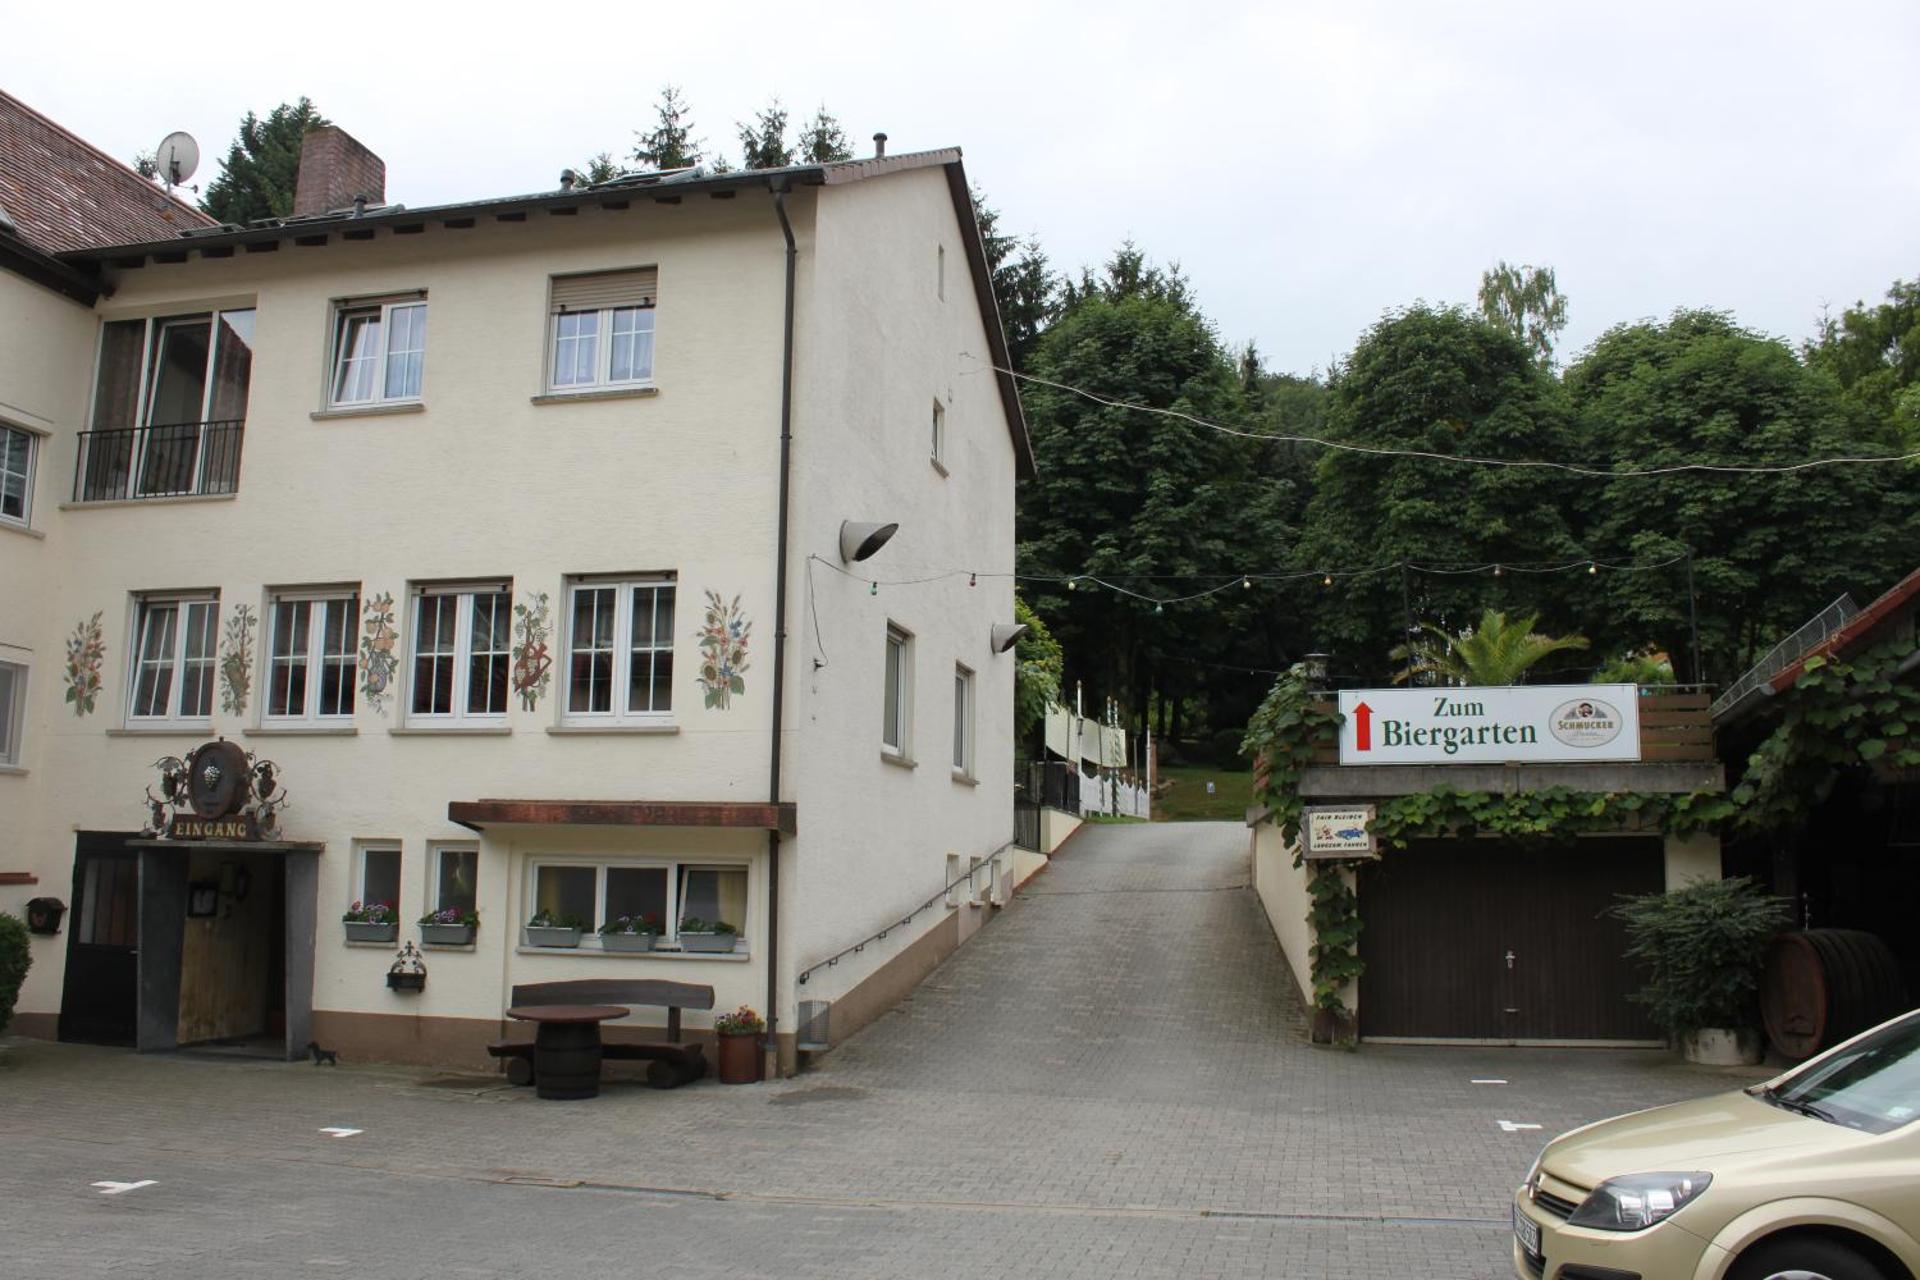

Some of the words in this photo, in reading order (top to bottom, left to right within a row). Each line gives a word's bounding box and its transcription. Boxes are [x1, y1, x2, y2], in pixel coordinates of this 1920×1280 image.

[1433, 697, 1484, 717] Zum
[1382, 720, 1537, 754] Biergarten
[176, 823, 246, 836] EINGANG
